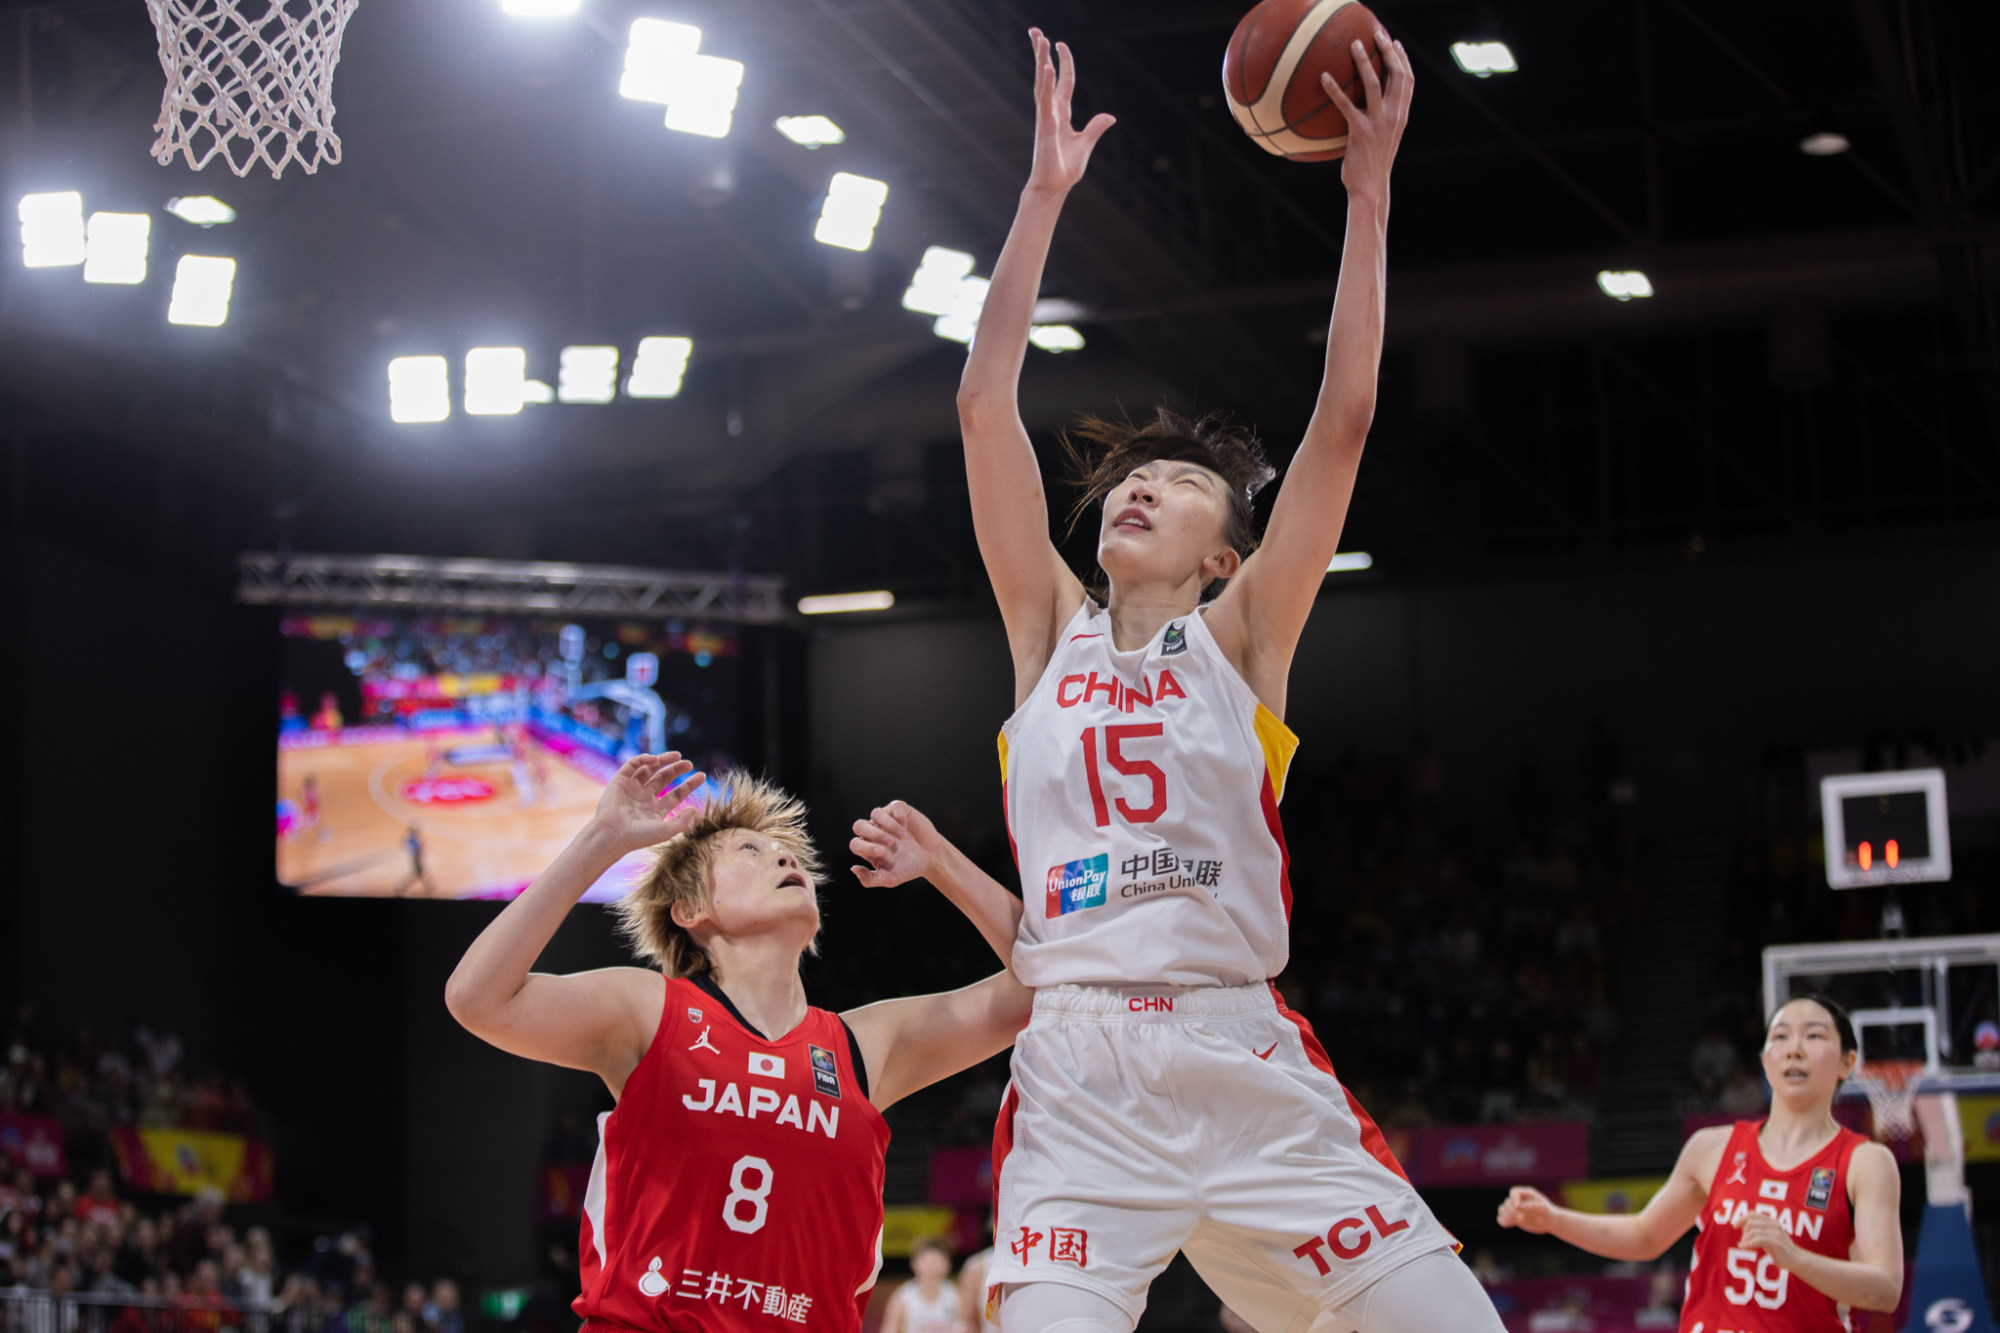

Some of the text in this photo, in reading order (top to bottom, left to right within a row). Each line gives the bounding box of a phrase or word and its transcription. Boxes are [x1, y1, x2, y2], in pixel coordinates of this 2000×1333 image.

[1056, 669, 1187, 714] CHINA
[1080, 722, 1167, 828] 15
[1048, 868, 1107, 894] UnionPay
[1120, 847, 1223, 887] 中国联
[1120, 882, 1166, 898] China
[1128, 997, 1173, 1013] CHN
[816, 1071, 836, 1086] FIBA
[682, 1078, 840, 1140] JAPAN
[722, 1154, 775, 1235] 8
[1010, 1225, 1088, 1269] 中国
[1292, 1204, 1409, 1278] TCL
[676, 1268, 814, 1325] 三井不動産
[1724, 1246, 1789, 1311] 59
